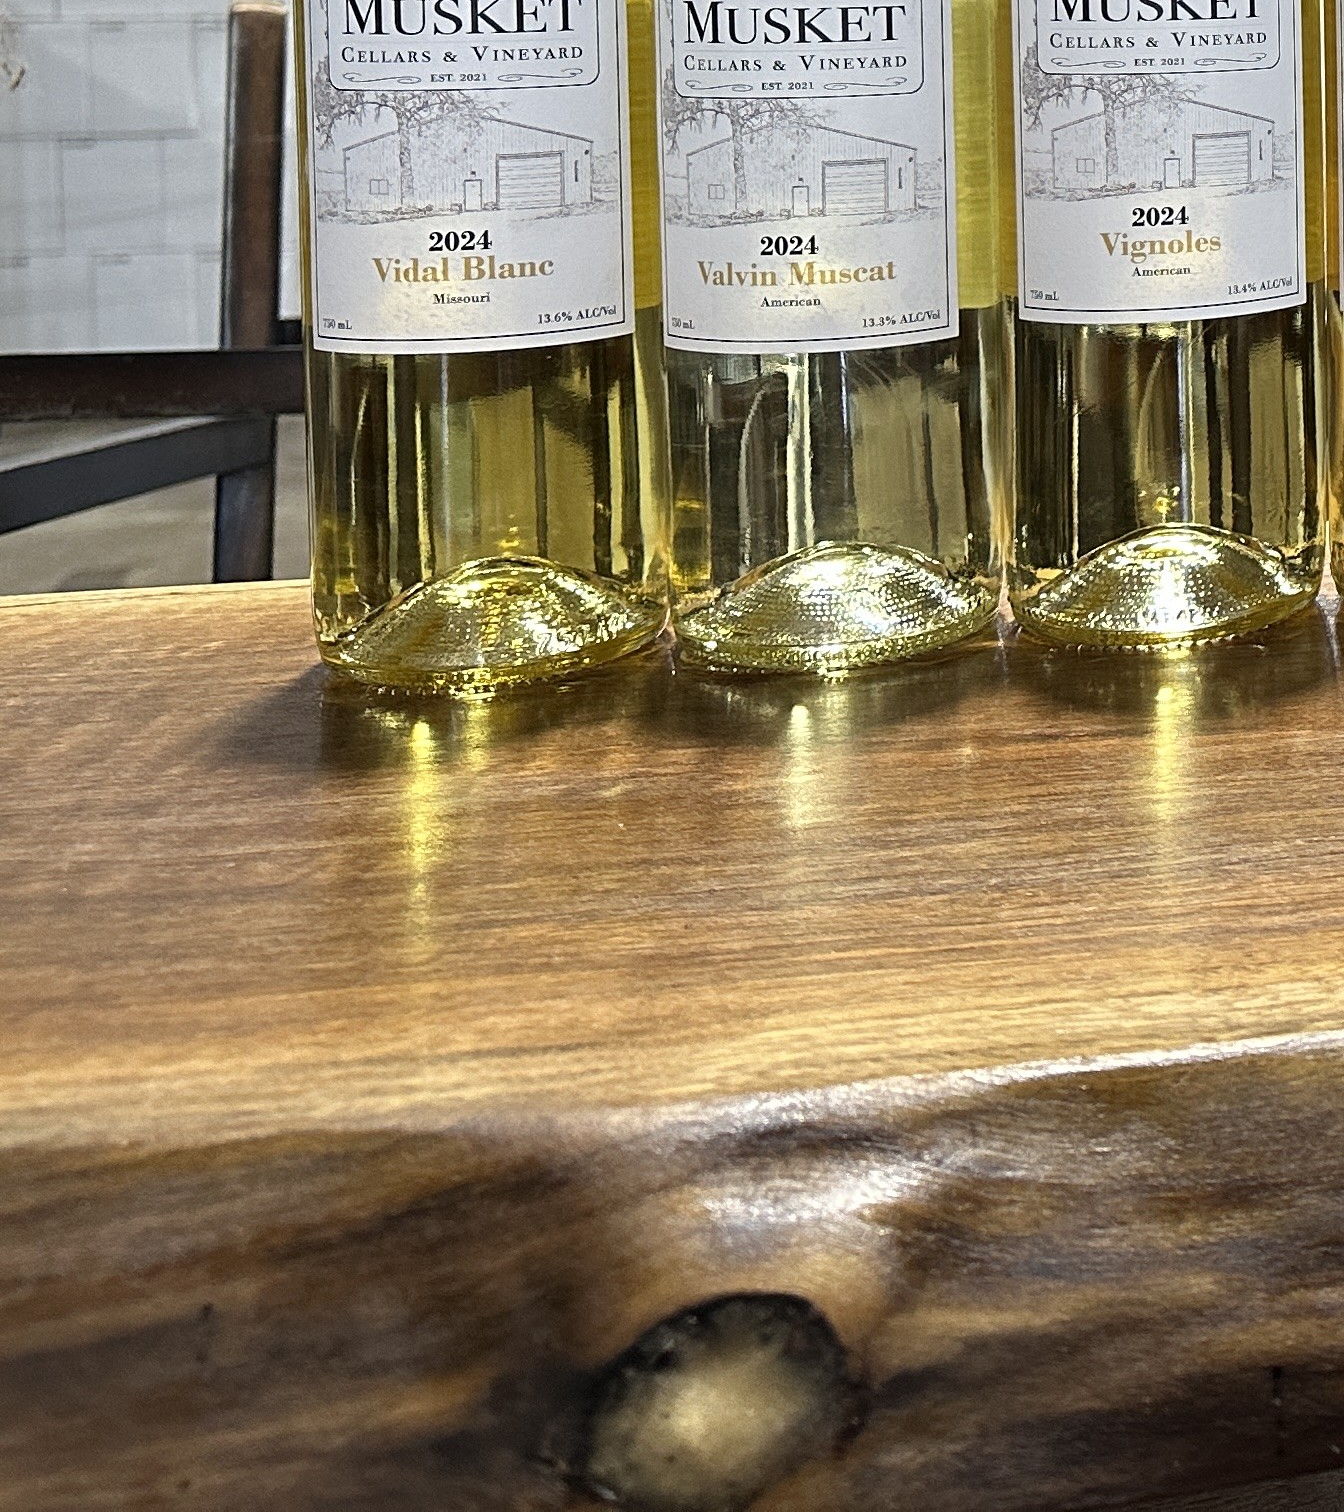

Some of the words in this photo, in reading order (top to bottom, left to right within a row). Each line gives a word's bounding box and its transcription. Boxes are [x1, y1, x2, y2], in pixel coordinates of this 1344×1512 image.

[682, 0, 906, 45] MUSKET
[1049, 32, 1135, 49] CELLARS
[1145, 37, 1158, 48] &
[1171, 31, 1267, 47] VINEYARD
[341, 44, 432, 64] CELLARS
[443, 50, 458, 62] &
[473, 45, 583, 62] VINEYARD
[683, 54, 762, 72] CELLARS
[772, 59, 786, 71] &
[799, 55, 907, 71] VINEYARD
[1161, 57, 1186, 66] 2021
[459, 72, 488, 82] 2021
[787, 81, 814, 90] 2021
[1132, 206, 1189, 227] 2024
[429, 230, 492, 252] 2024
[760, 235, 819, 255] 2024
[1100, 230, 1222, 264] Vignoles
[372, 257, 451, 283] Vidal
[462, 256, 554, 281] Blanc
[698, 261, 777, 286] Valvin
[788, 261, 897, 286] Muscat
[1131, 266, 1191, 277] American
[433, 291, 490, 304] Missouri
[760, 297, 821, 307] American
[537, 311, 572, 324] 13.6%
[862, 316, 896, 328] 13.3%
